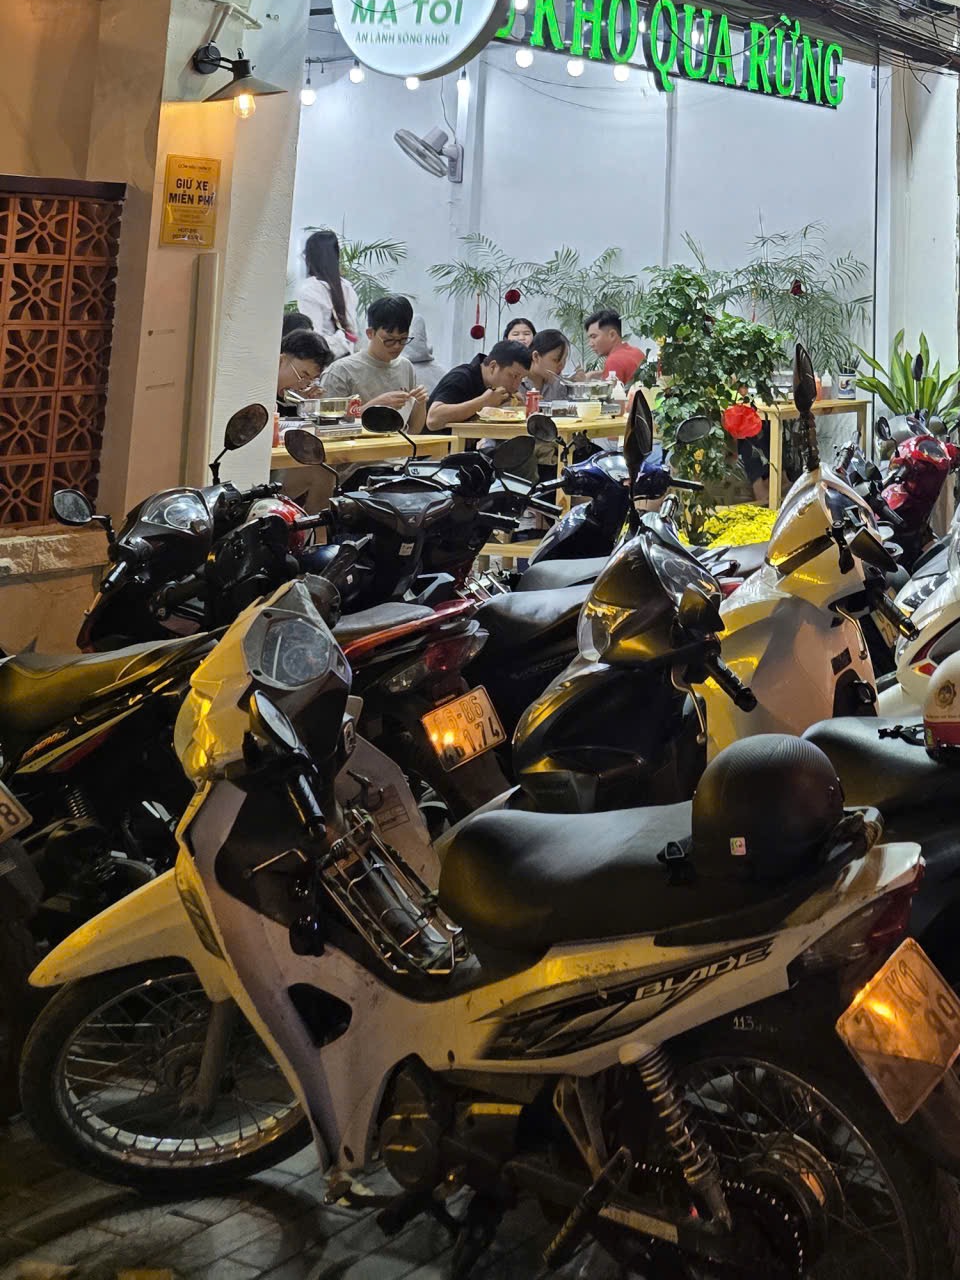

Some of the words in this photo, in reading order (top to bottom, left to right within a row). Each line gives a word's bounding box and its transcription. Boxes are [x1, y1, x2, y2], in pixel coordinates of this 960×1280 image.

[748, 12, 845, 107] RỪNG
[168, 190, 195, 205] MIỄN
[195, 180, 209, 191] XE
[634, 942, 775, 1002] BLADE
